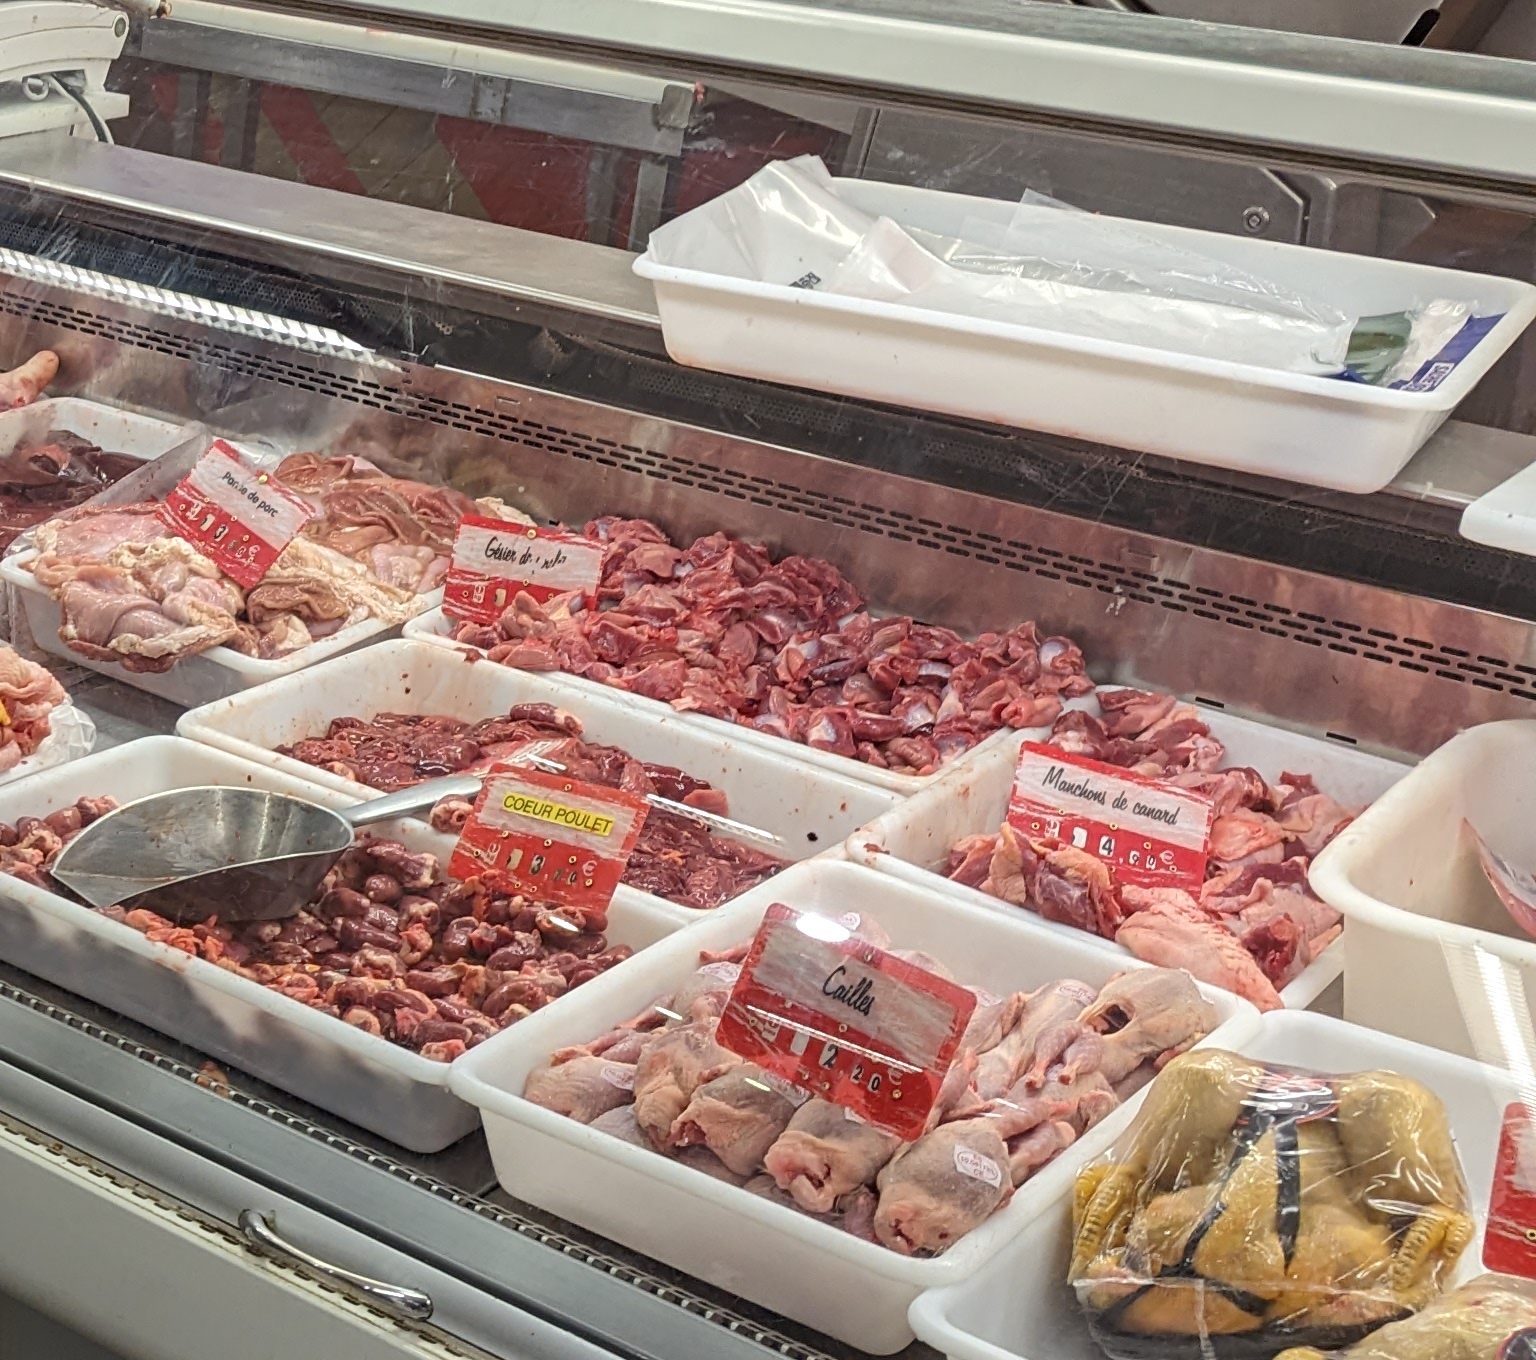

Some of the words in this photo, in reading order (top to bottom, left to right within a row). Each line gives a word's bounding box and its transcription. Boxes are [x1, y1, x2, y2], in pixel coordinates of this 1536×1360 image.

[256, 501, 279, 518] porc
[504, 795, 553, 818] COEUR
[554, 808, 613, 834] POULET
[1042, 766, 1107, 806] Manchons
[1112, 791, 1129, 811] de
[1132, 802, 1181, 826] canard
[822, 965, 877, 1017] Cailles
